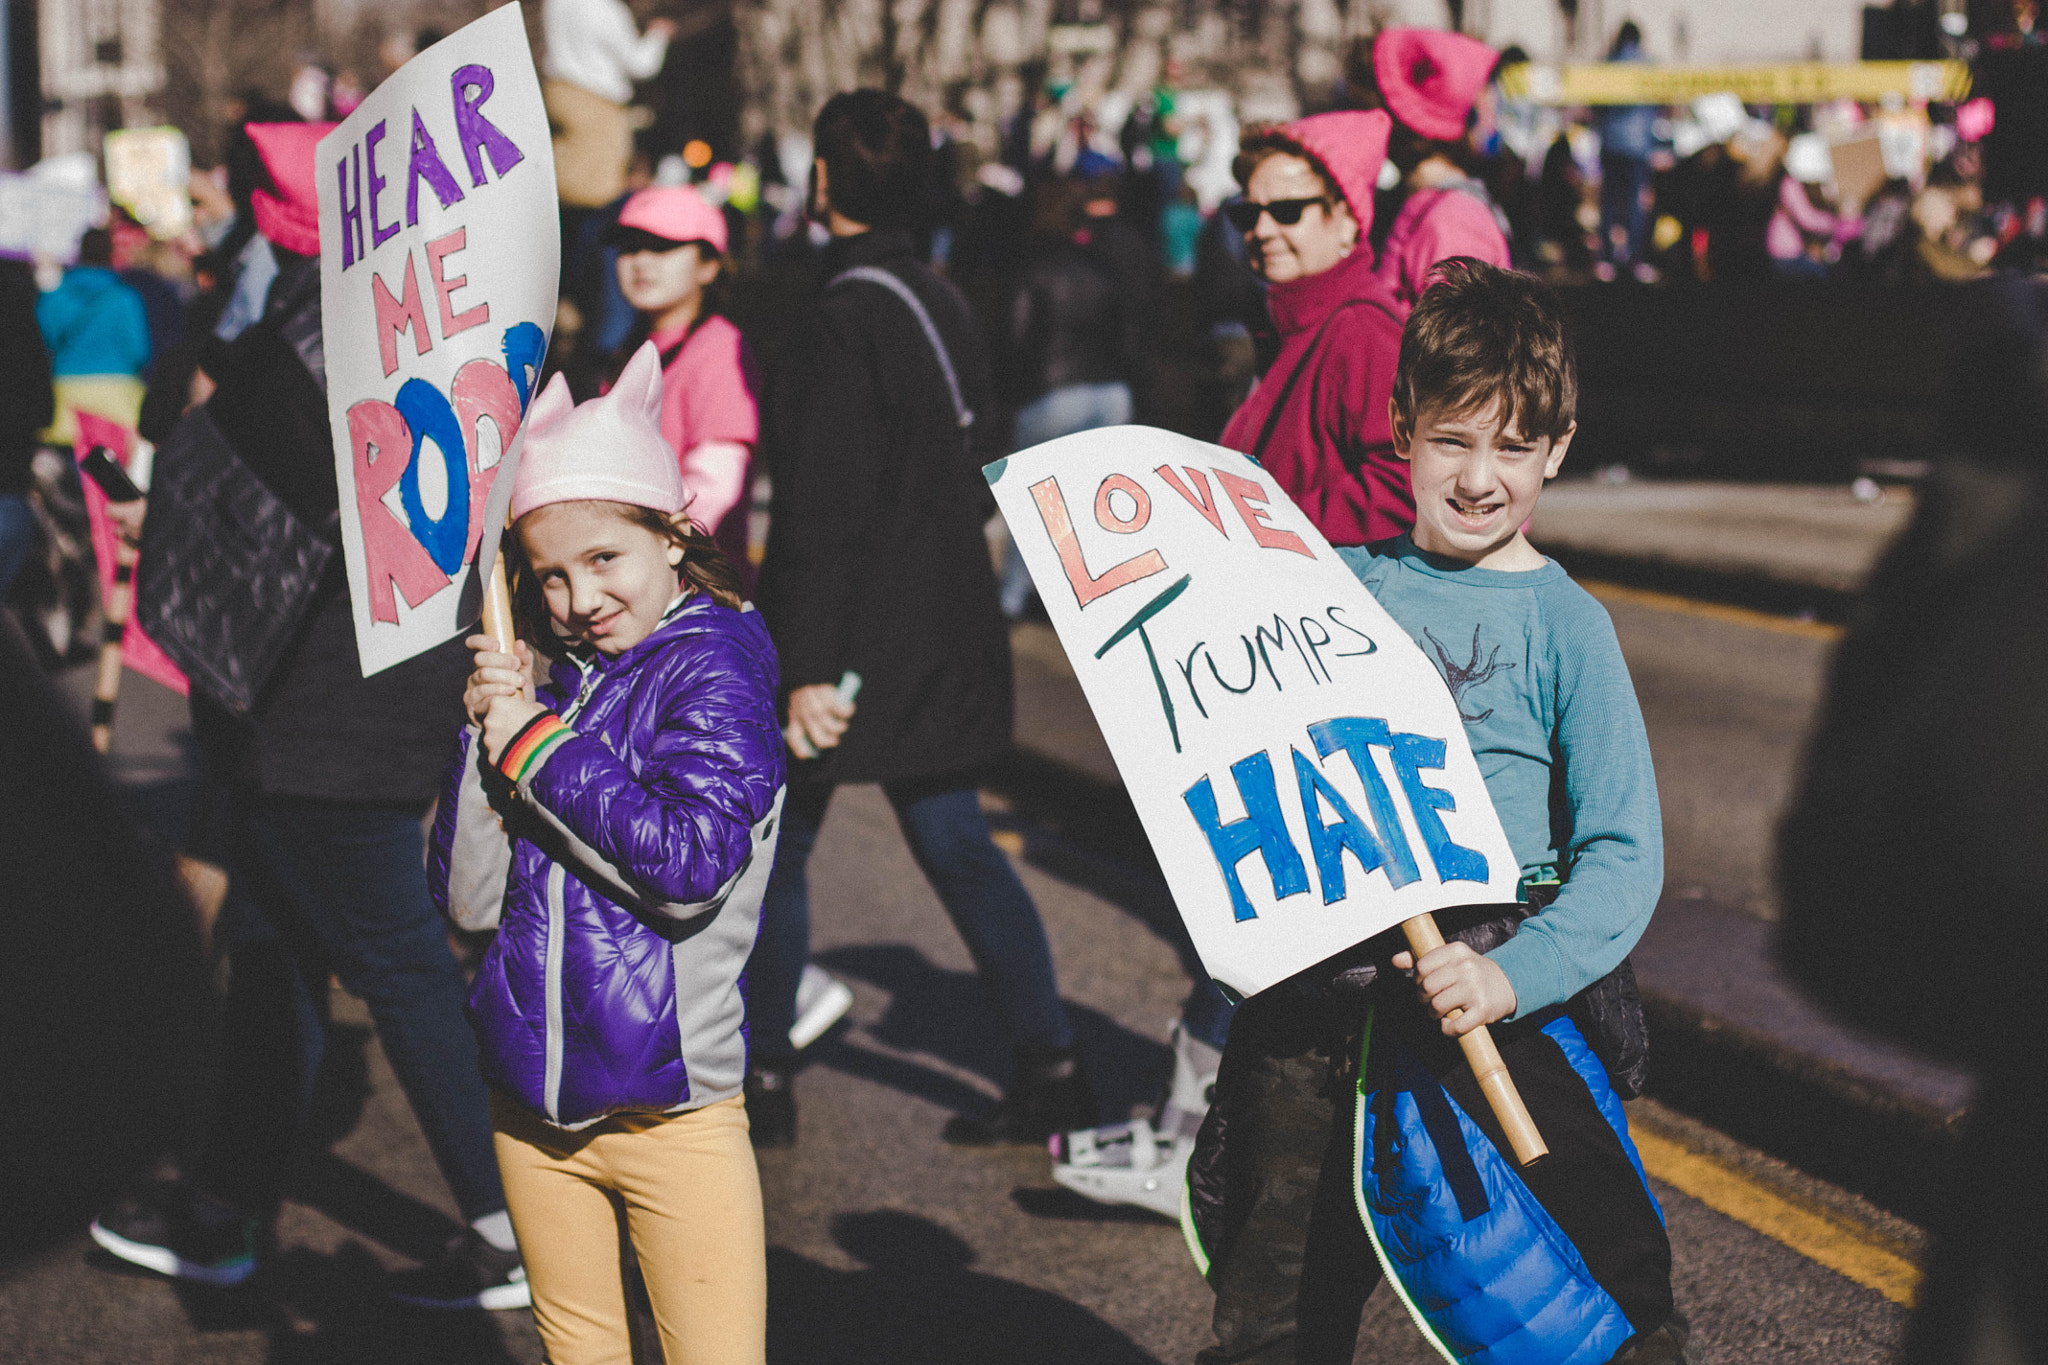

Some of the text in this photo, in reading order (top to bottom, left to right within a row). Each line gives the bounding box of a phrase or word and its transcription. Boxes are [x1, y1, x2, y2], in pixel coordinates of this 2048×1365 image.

[337, 64, 524, 271] HEAR
[372, 226, 489, 377] ME
[1028, 464, 1317, 609] LOVE
[1181, 717, 1489, 922] HATE
